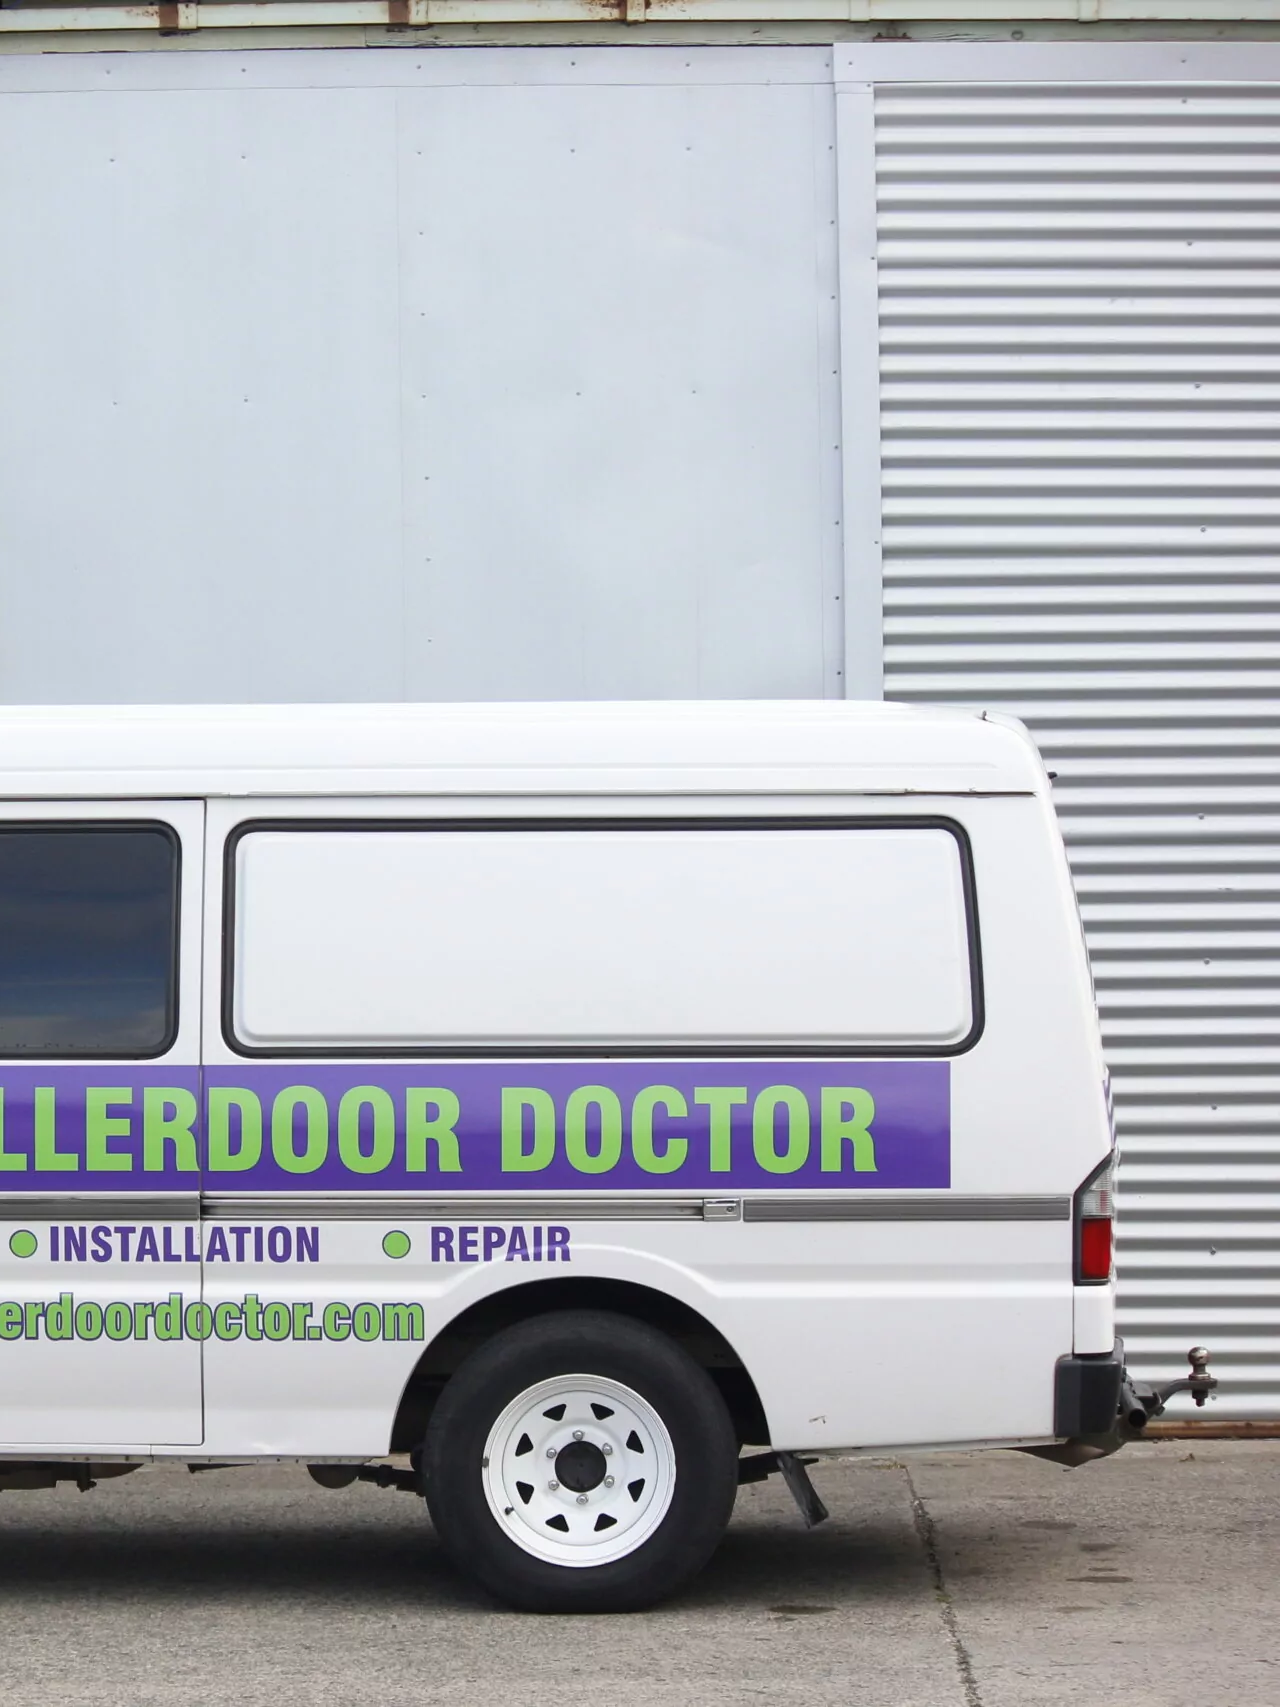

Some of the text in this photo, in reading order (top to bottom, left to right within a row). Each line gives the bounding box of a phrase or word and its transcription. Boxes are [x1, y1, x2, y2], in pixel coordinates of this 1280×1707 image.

[501, 1085, 877, 1174] DOCTOR
[50, 1225, 320, 1263] INSTALLATION
[431, 1225, 571, 1263] REPAIR
